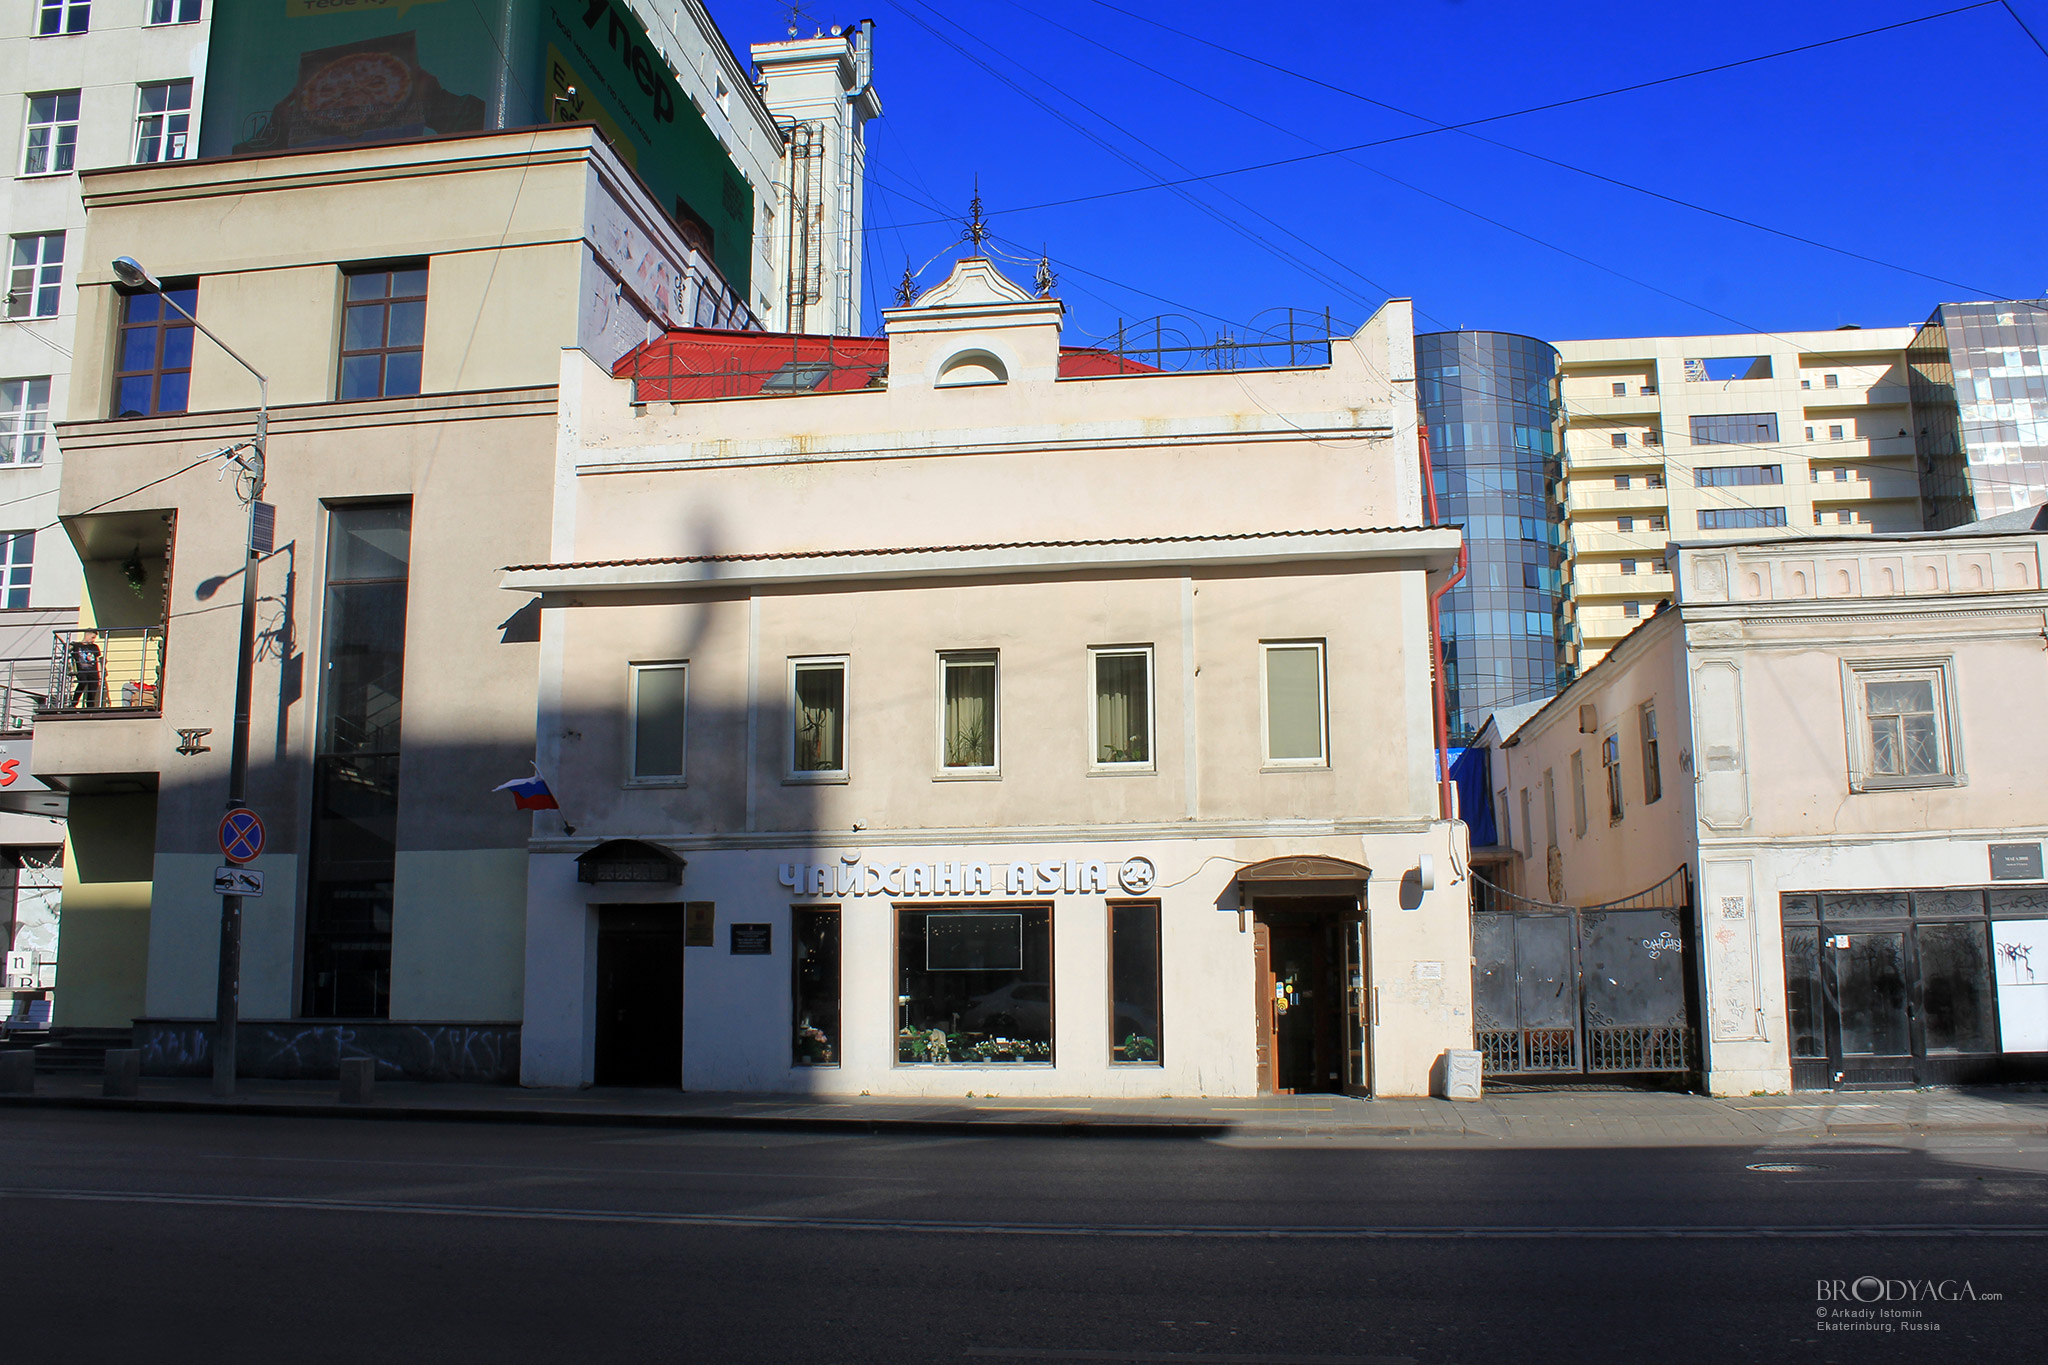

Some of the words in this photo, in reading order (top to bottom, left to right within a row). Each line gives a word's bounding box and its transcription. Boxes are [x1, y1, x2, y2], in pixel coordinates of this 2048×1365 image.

[573, 40, 606, 86] человек
[617, 98, 652, 146] покупкам
[777, 851, 991, 897] ЧАЙХАНА
[1006, 859, 1108, 895] ASIA
[1122, 862, 1153, 886] 24
